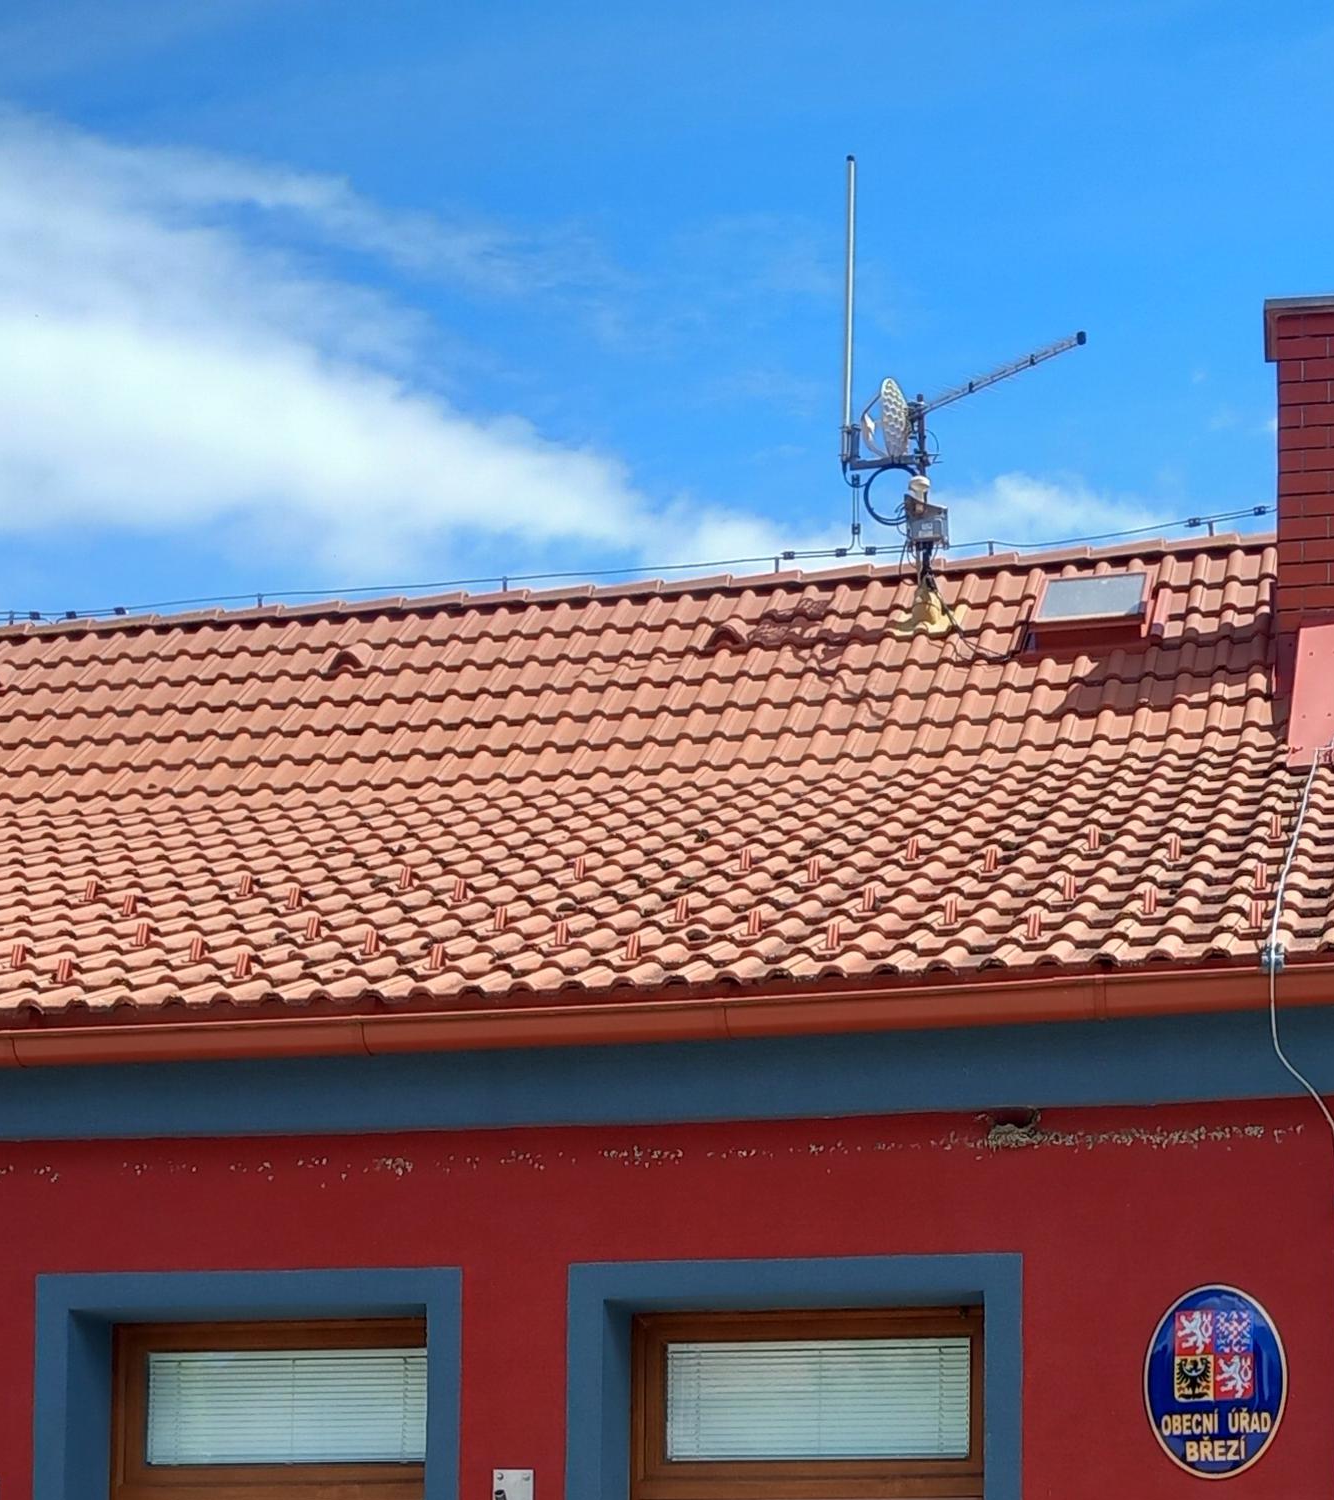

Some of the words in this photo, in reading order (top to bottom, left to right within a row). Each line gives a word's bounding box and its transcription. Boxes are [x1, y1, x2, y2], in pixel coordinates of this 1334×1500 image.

[1161, 1408, 1219, 1436] OBECNÍ
[1228, 1407, 1271, 1433] ÚŘAD
[1185, 1436, 1246, 1462] BŘEZÍ
